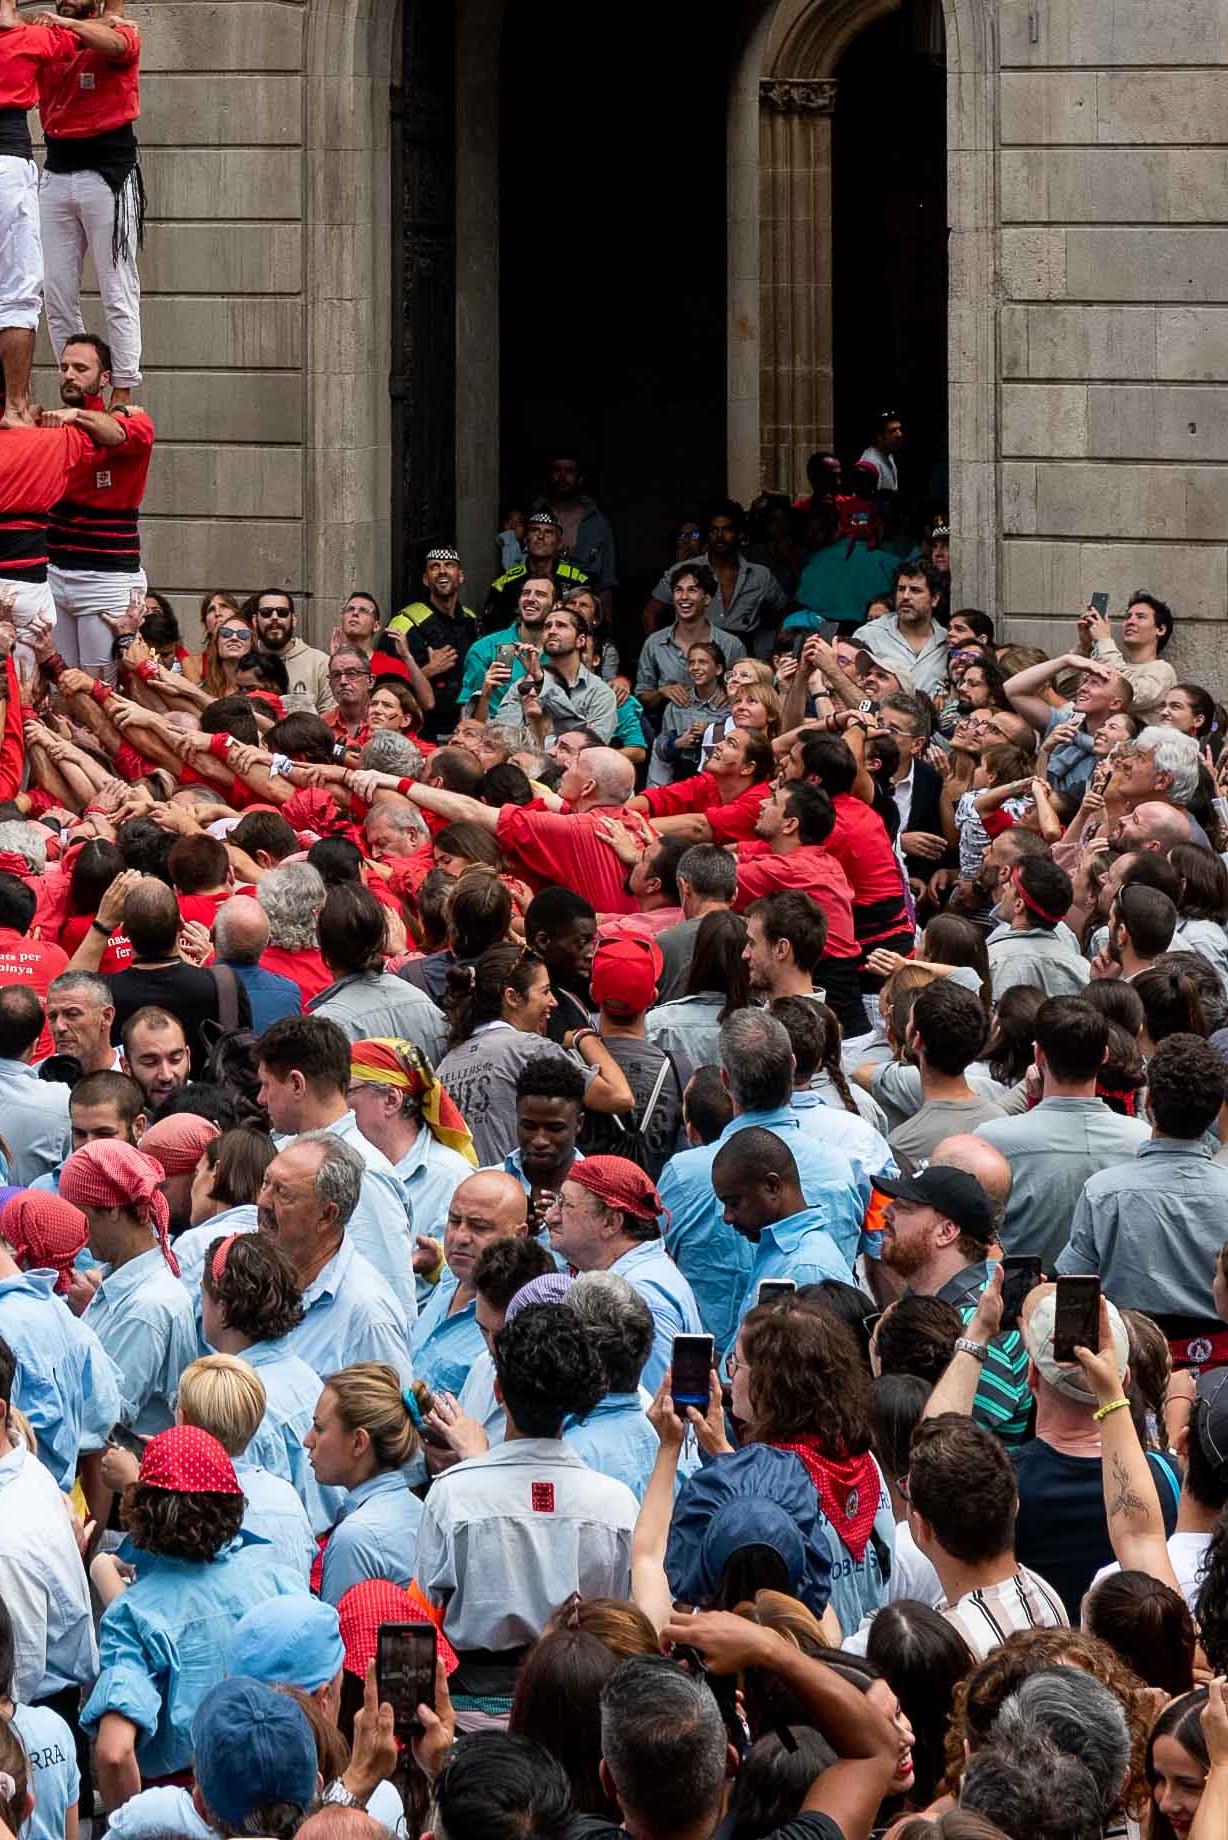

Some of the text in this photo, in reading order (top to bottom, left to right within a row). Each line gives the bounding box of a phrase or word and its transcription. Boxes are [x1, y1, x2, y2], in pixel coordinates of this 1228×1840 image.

[19, 952, 42, 963] per
[115, 946, 131, 959] fer
[28, 1743, 66, 1771] RRA
